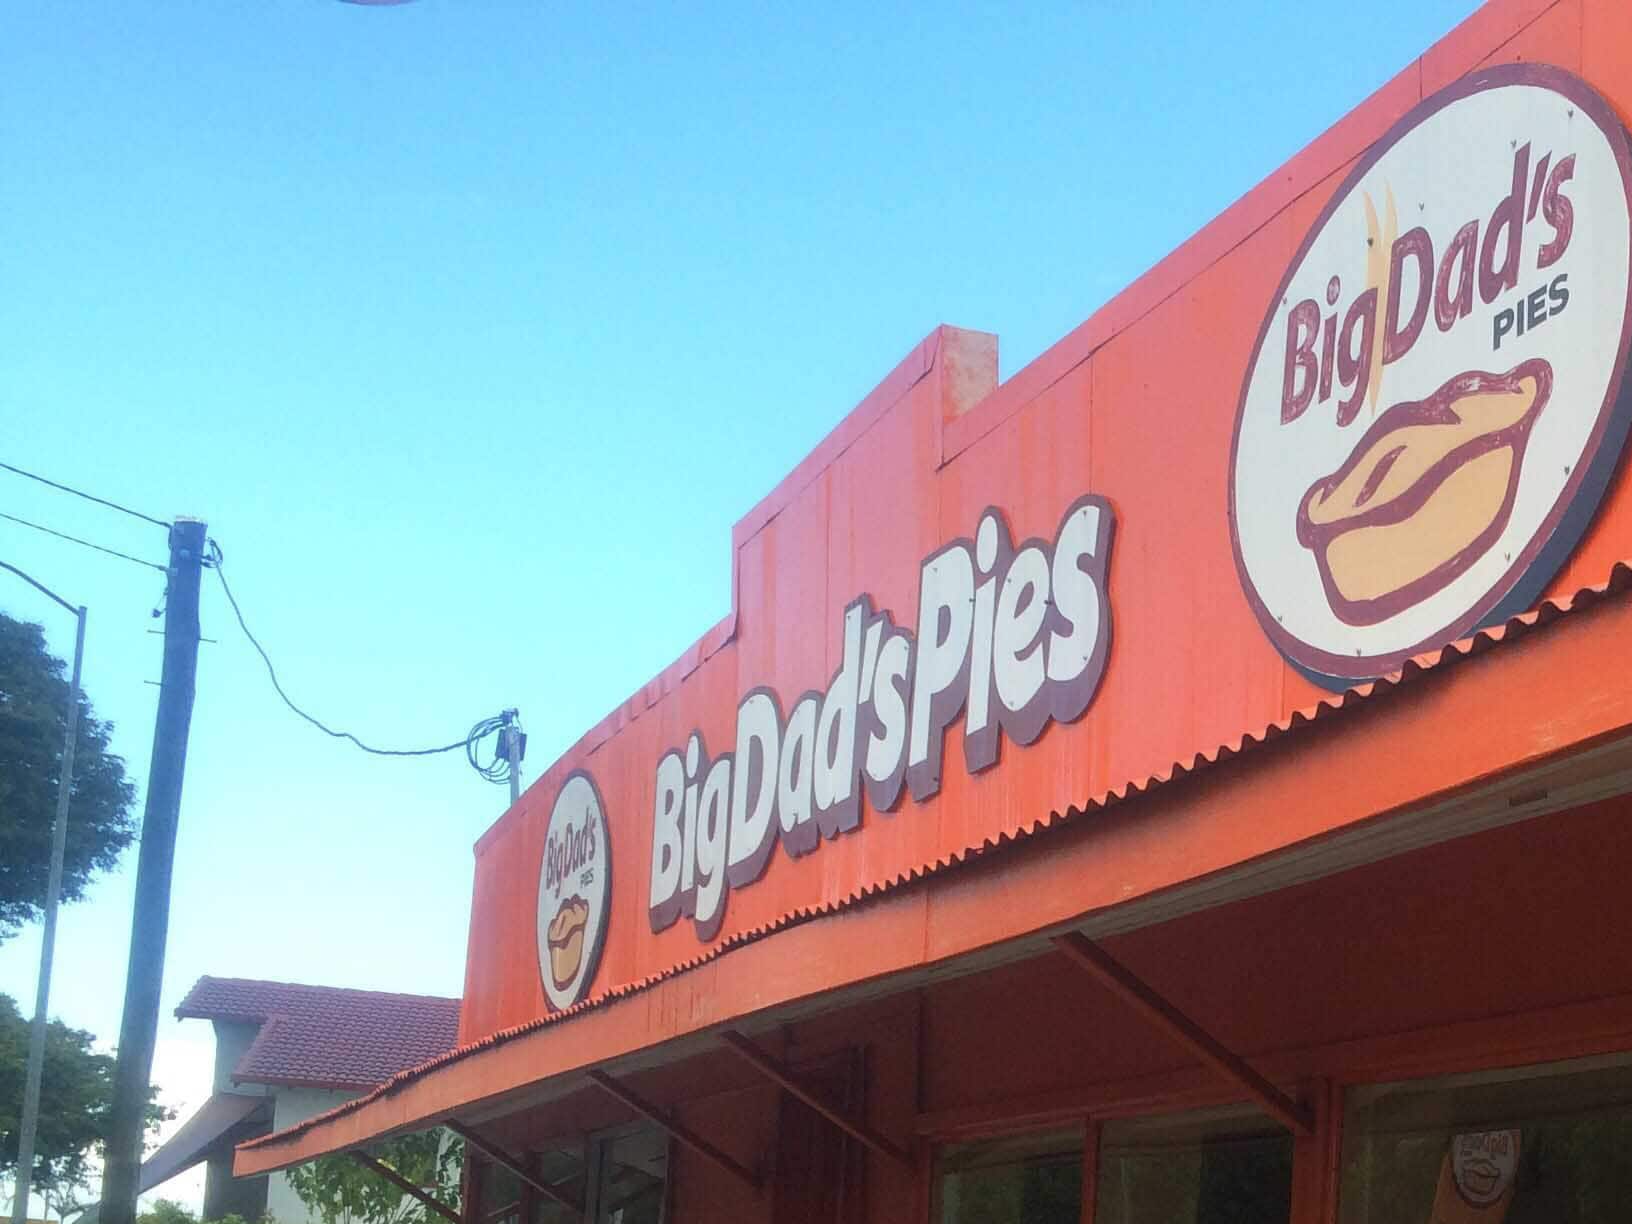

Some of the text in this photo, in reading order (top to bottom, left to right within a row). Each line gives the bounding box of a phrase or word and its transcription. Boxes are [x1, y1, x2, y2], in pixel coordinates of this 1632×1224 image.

[1280, 140, 1576, 427] Big Dad's
[1493, 273, 1569, 351] PIES
[909, 504, 1100, 767] Pies
